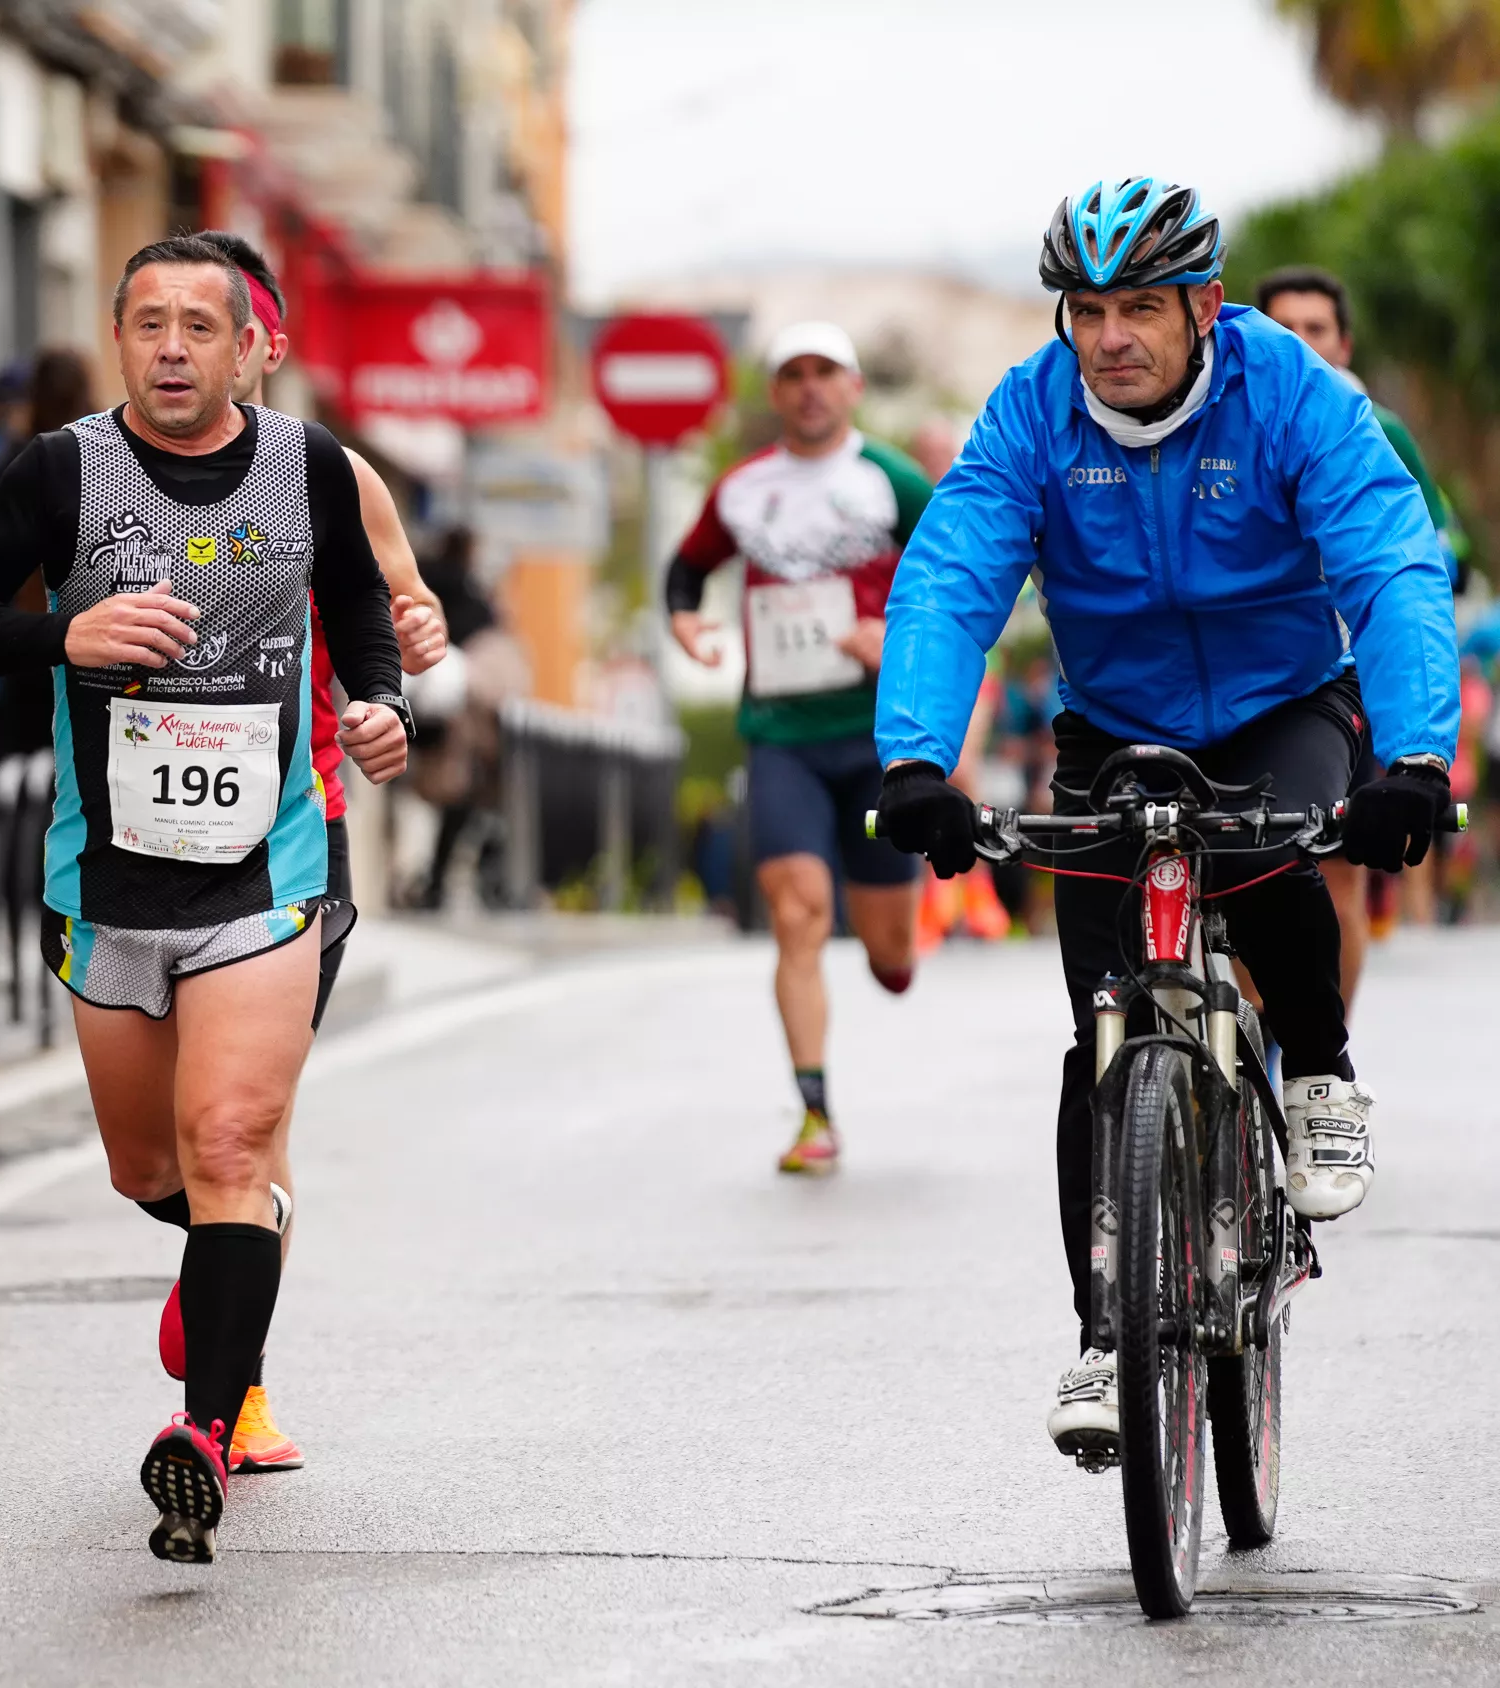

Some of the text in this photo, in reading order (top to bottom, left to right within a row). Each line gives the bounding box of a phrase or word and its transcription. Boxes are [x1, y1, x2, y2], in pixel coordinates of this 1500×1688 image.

[1199, 458, 1237, 471] ETERIA
[114, 541, 141, 555] CLUB
[113, 554, 173, 569] ATLETISMO
[121, 567, 172, 582] TRIATLON
[176, 732, 231, 751] LUCENA
[152, 764, 240, 807] 196
[154, 817, 179, 826] MANUEL
